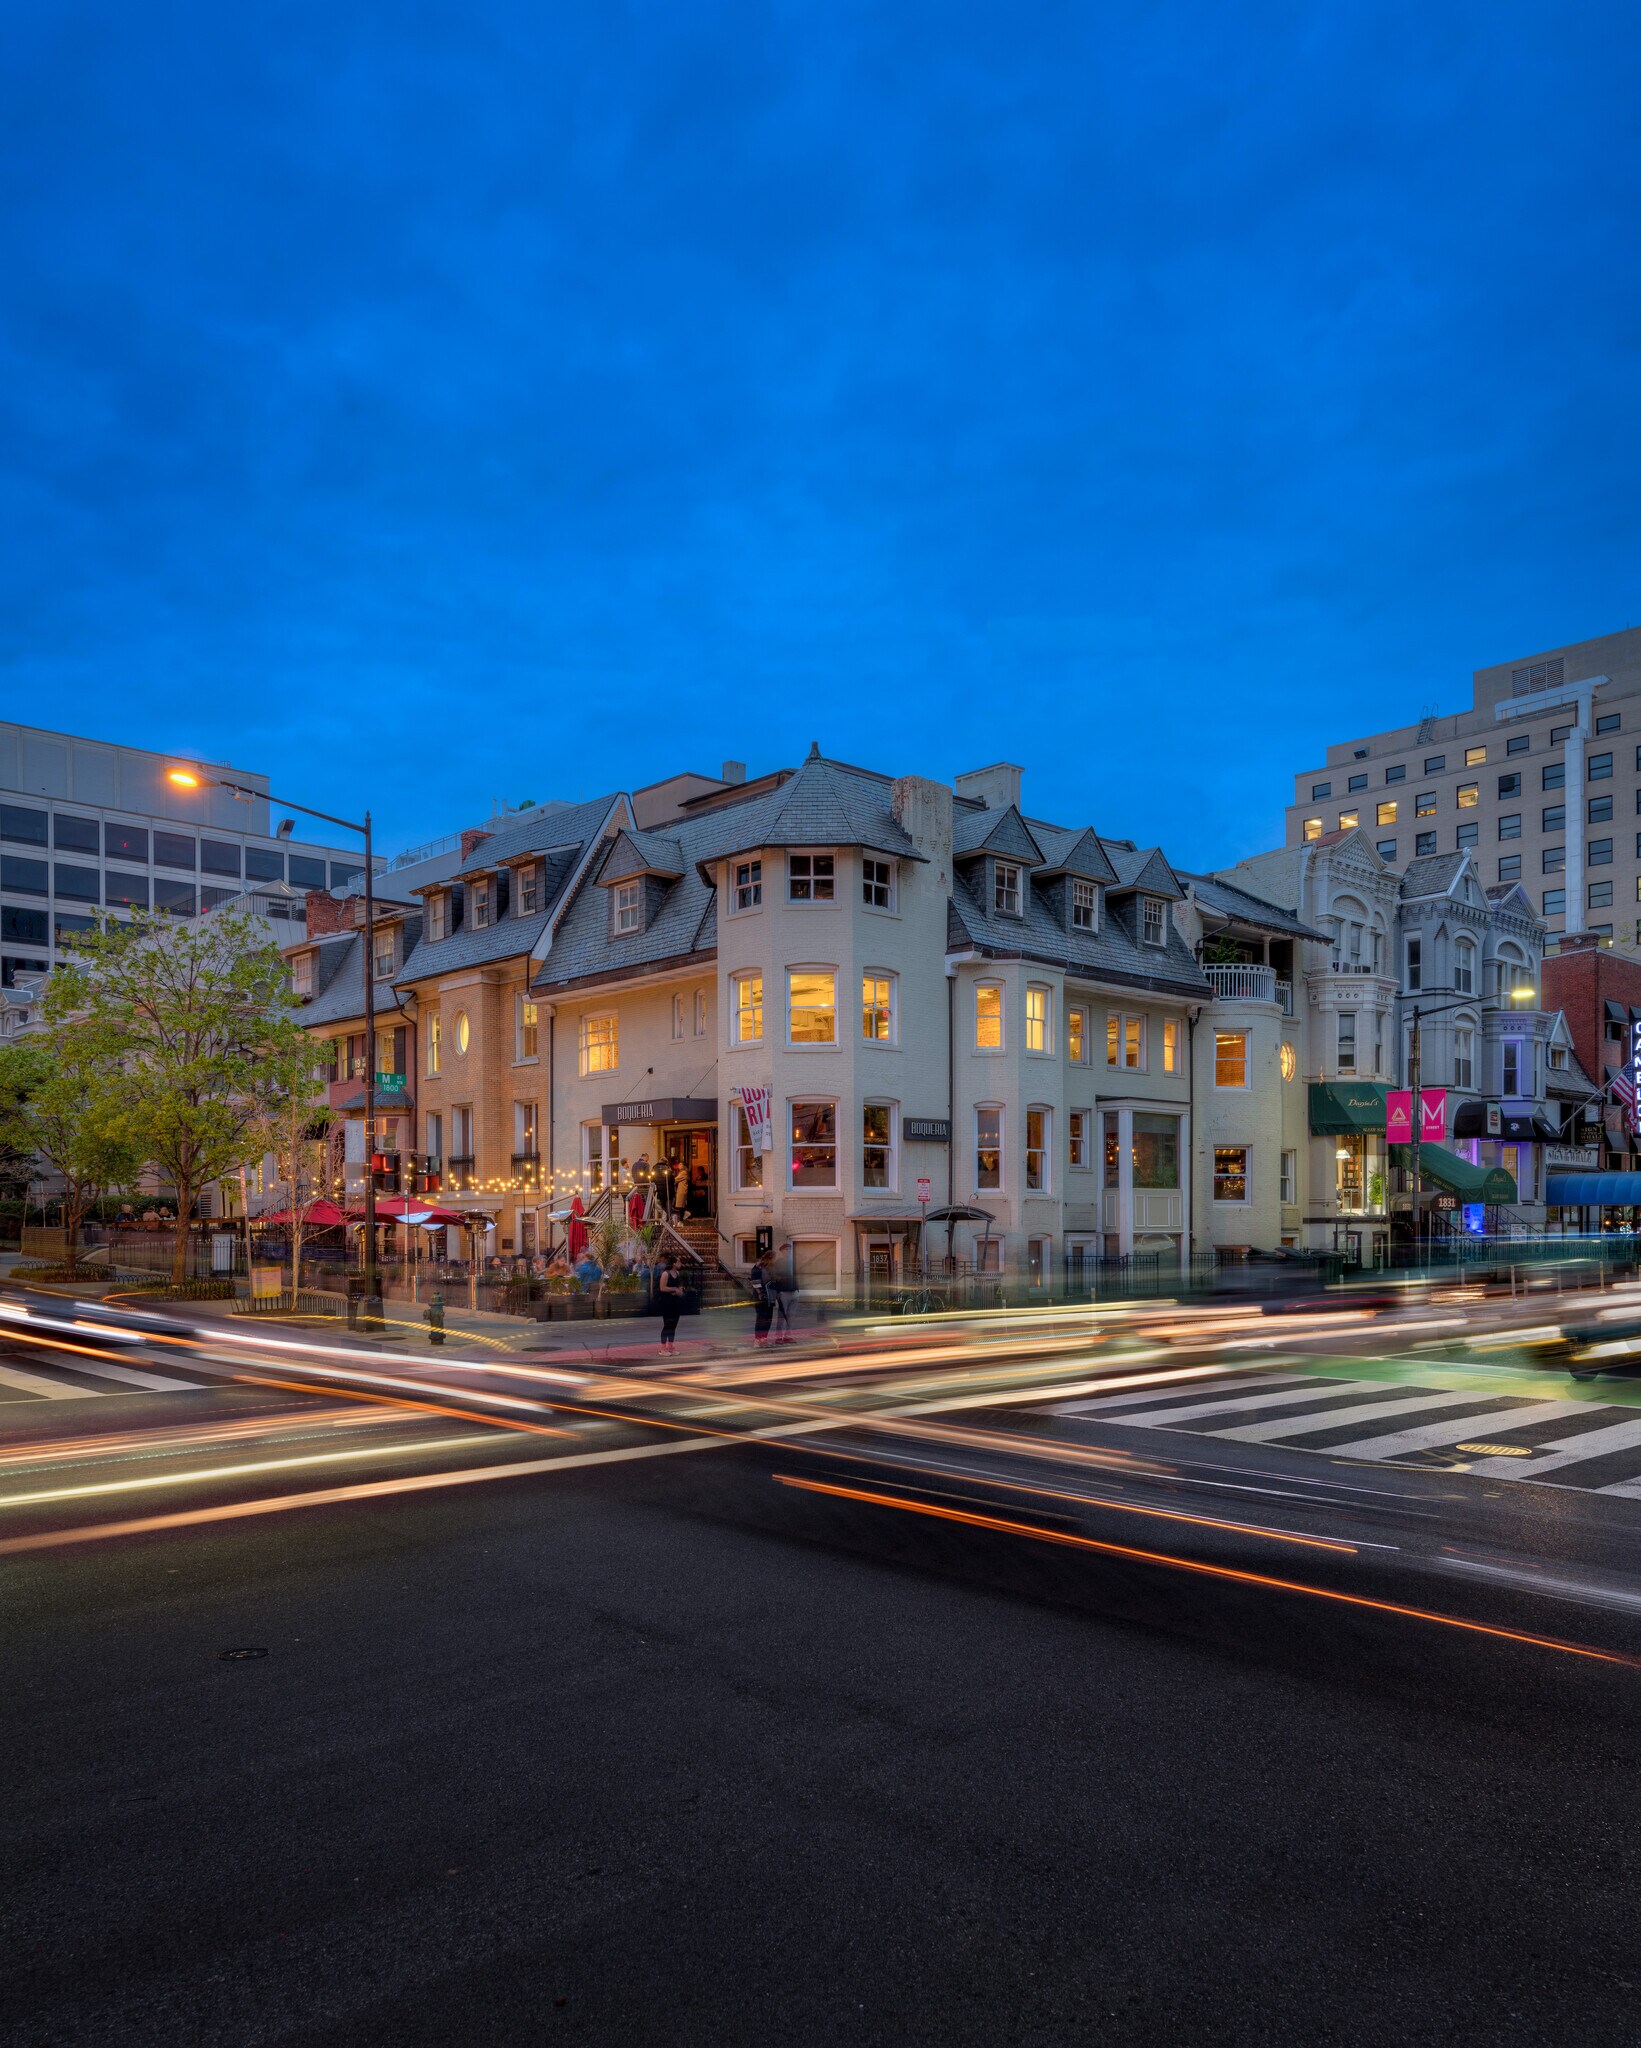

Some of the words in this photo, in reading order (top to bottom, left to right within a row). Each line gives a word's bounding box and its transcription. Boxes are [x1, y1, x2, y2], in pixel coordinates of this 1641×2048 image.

[382, 1074, 391, 1084] M
[383, 1084, 399, 1092] 1800
[617, 1103, 654, 1121] BOQUERIA
[1421, 1097, 1445, 1126] M
[911, 1121, 947, 1137] BOQUERIA
[1548, 1149, 1563, 1160] SIGN
[1570, 1150, 1592, 1163] WHALE
[1438, 1197, 1456, 1208] 1831
[872, 1254, 888, 1263] 1837
